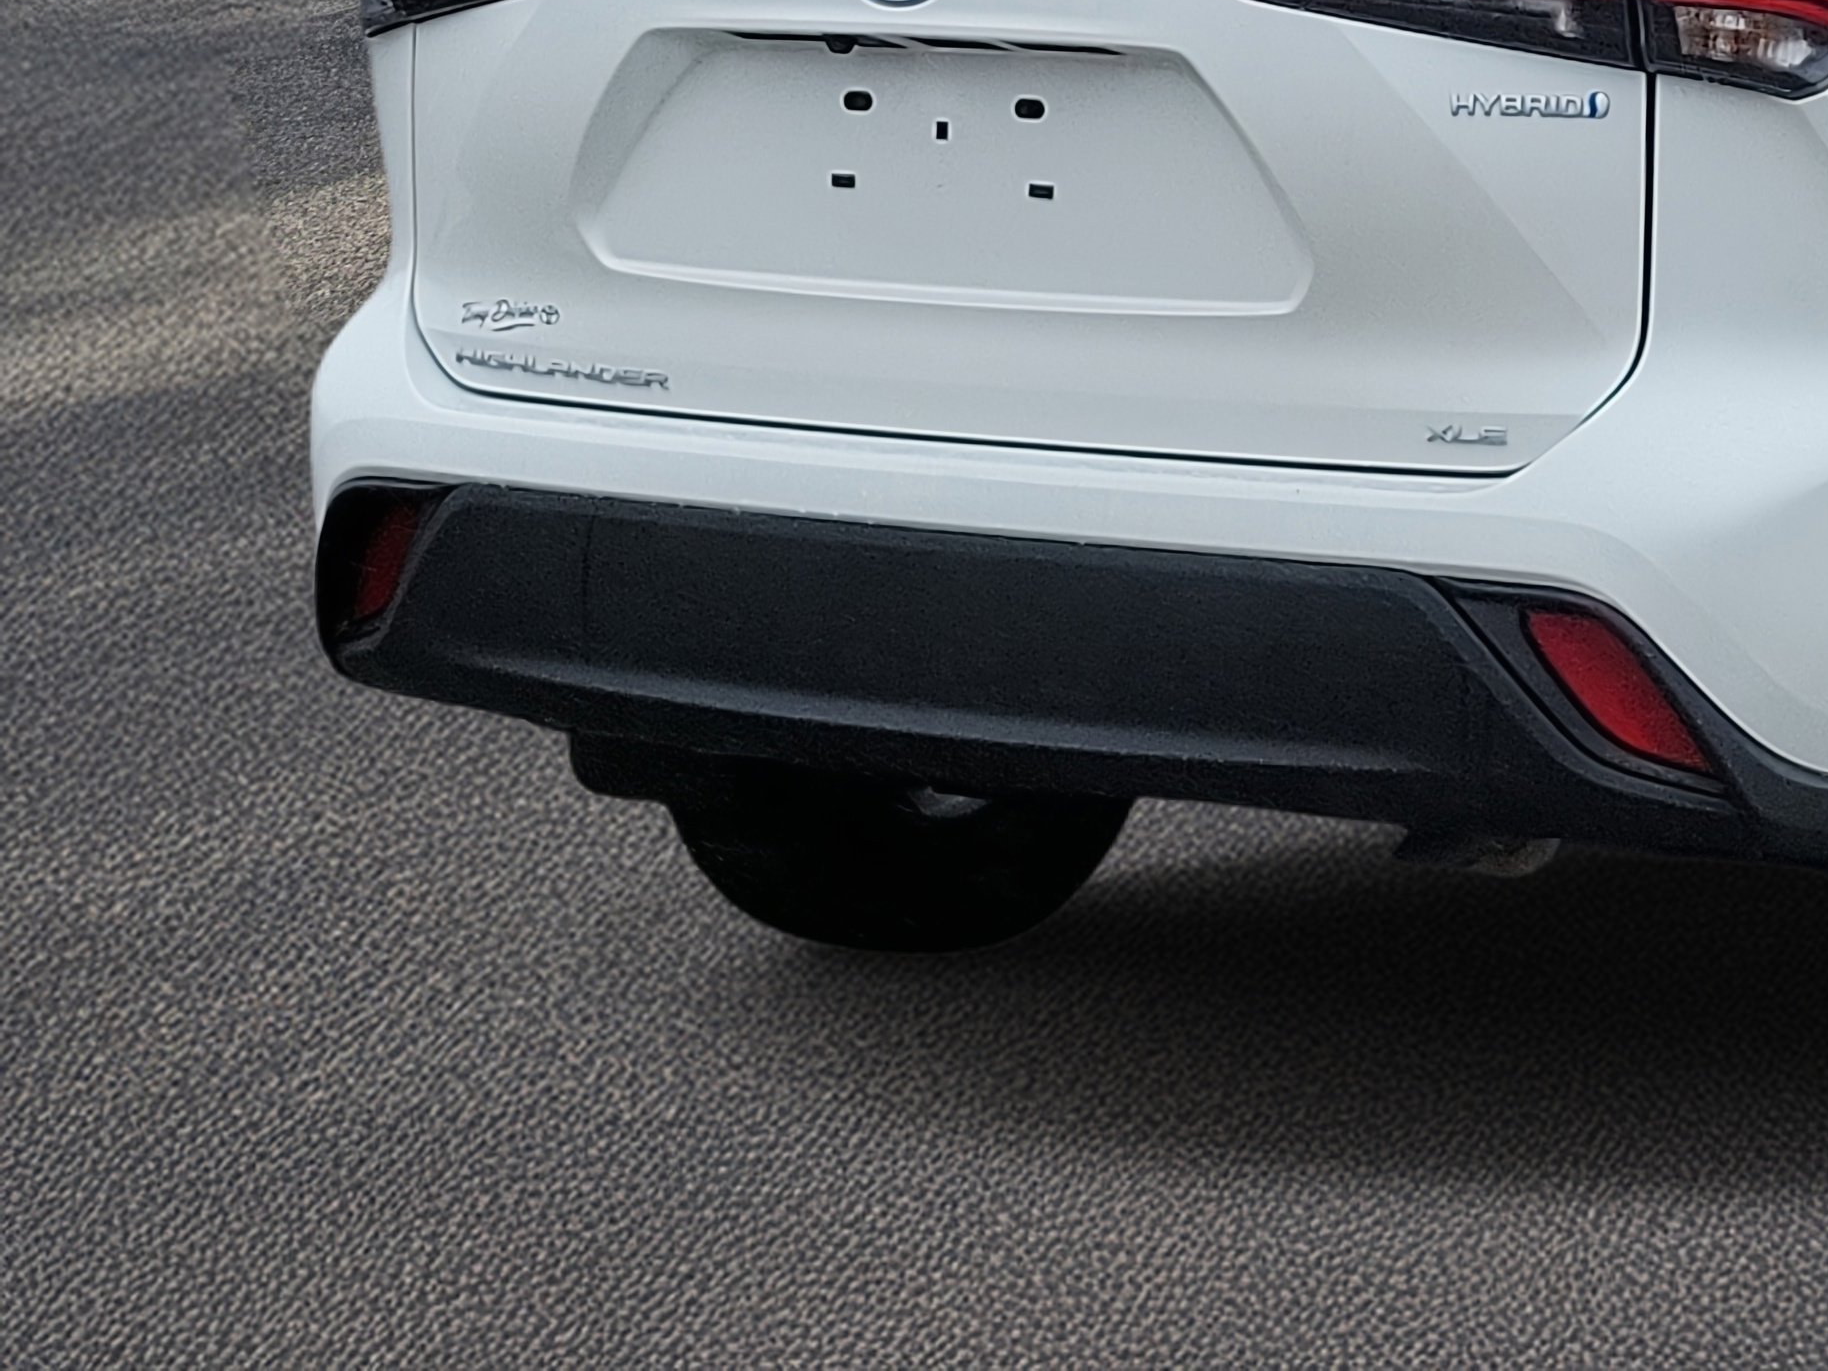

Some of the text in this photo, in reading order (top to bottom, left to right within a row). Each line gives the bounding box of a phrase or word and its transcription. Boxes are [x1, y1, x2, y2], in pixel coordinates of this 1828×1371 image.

[1450, 92, 1584, 118] HYBRID
[455, 346, 670, 391] HIGHLANDER
[1426, 423, 1508, 446] XLE
